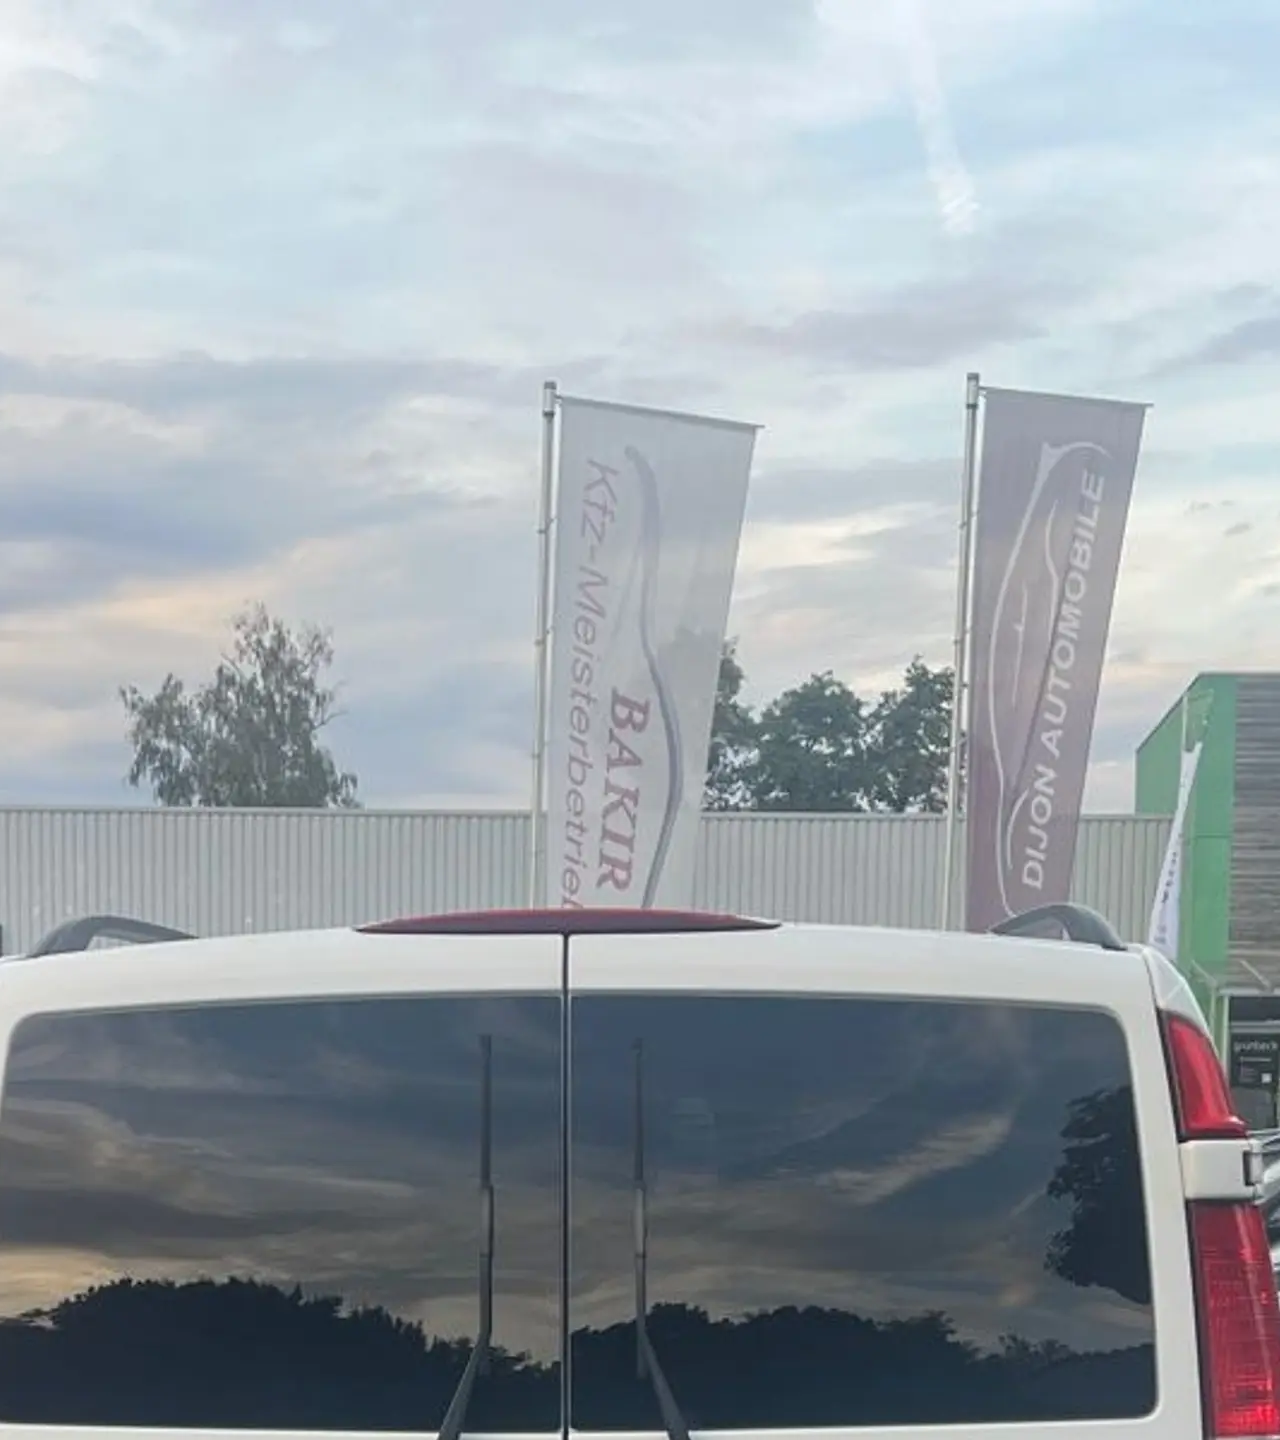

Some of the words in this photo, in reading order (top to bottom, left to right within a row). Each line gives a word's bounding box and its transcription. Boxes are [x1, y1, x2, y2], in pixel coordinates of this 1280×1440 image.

[594, 686, 652, 894] BAKIR
[1021, 764, 1059, 891] DIJON
[1040, 467, 1106, 760] AUTOMOBILE
